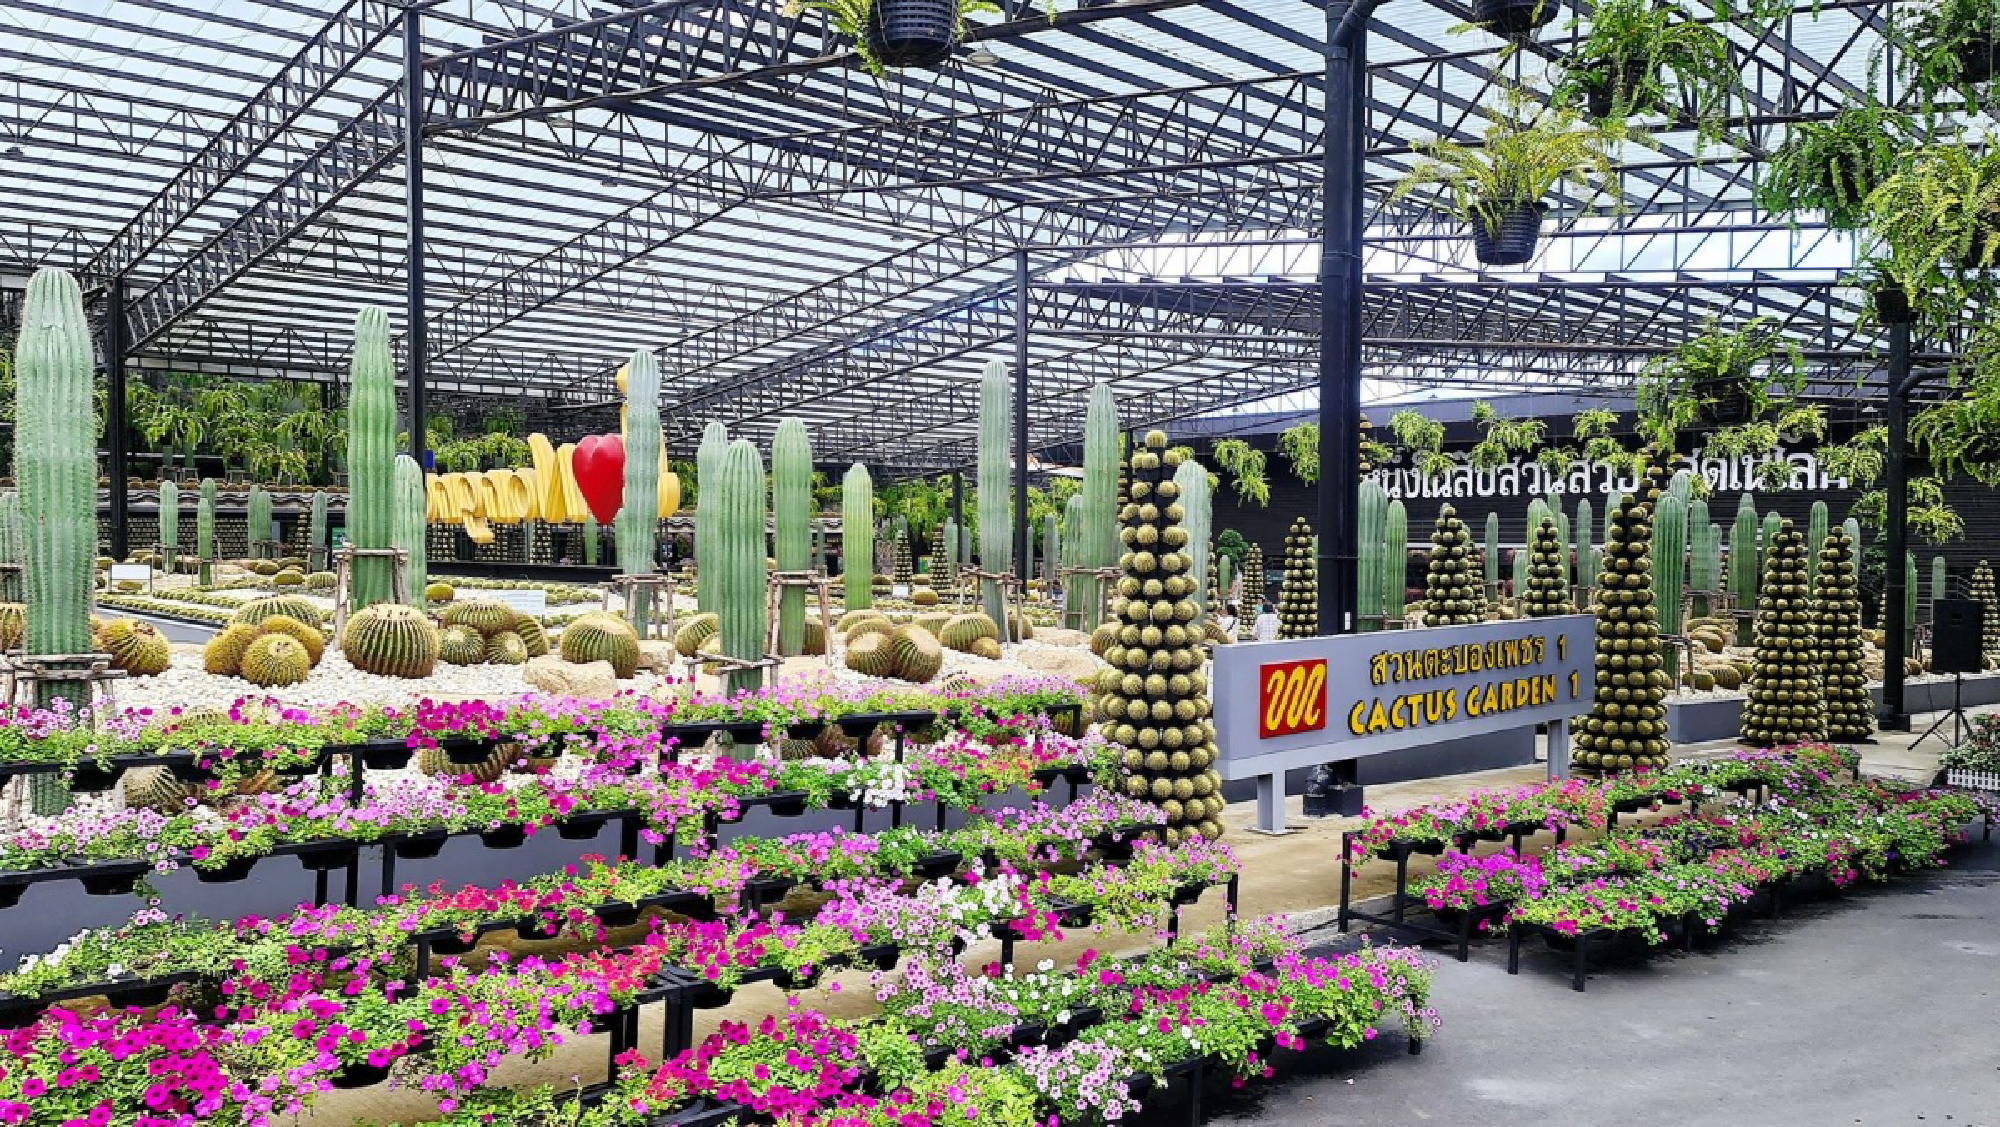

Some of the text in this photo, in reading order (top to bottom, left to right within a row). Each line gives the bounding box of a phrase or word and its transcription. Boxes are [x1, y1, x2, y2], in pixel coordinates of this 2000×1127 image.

[1557, 634, 1567, 660] 1
[1348, 688, 1457, 735] CACTUS
[1466, 674, 1557, 717] GARDEN
[1568, 669, 1579, 698] 1
